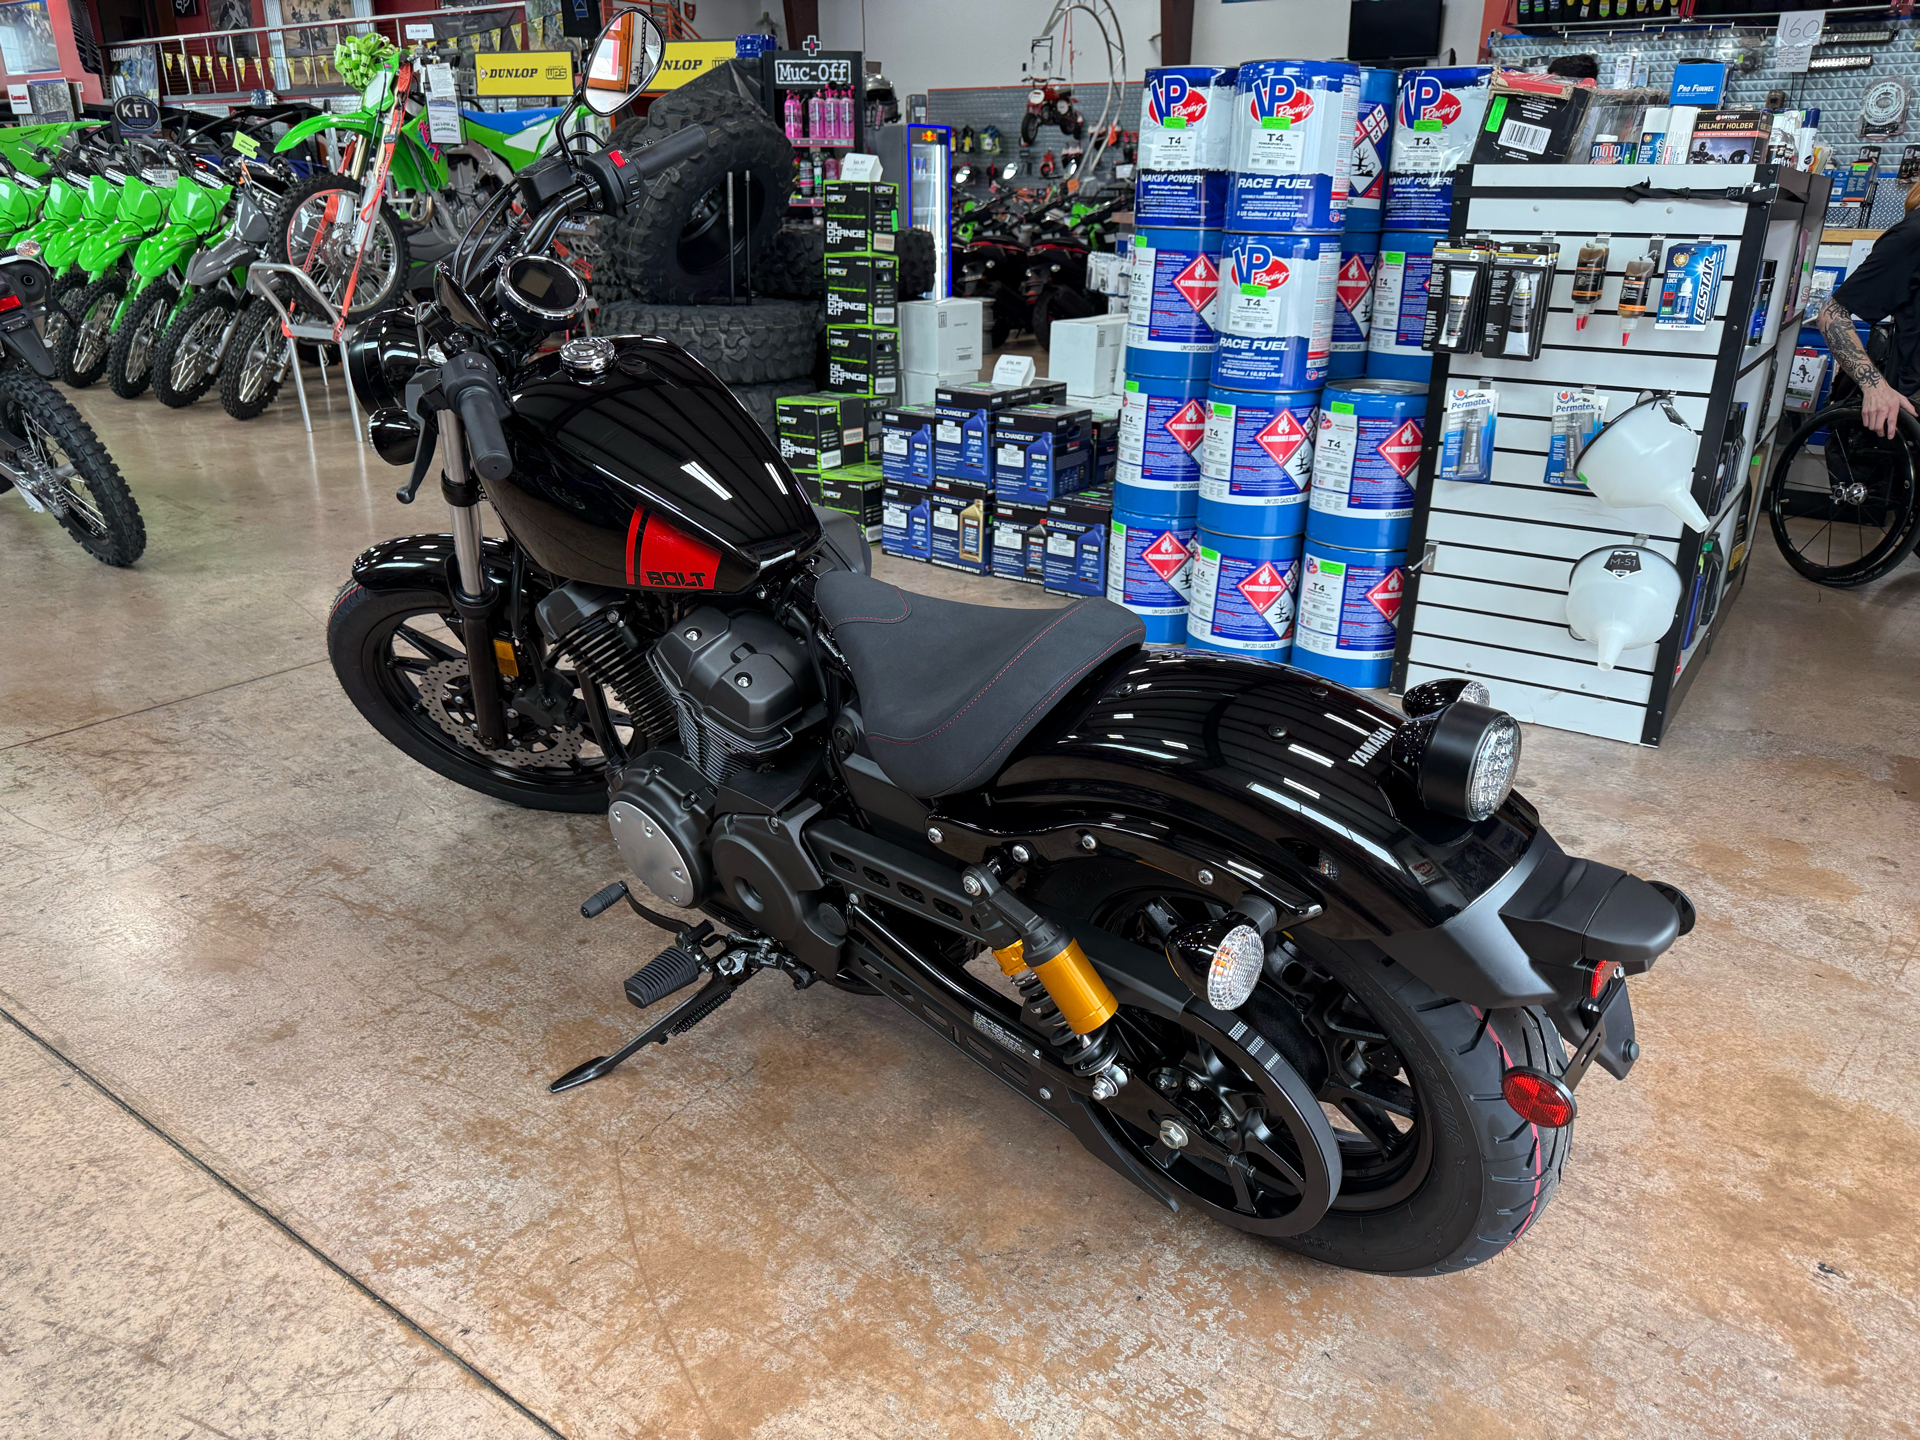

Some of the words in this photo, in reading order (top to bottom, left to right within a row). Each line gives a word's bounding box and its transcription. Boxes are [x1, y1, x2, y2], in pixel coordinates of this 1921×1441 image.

[1782, 18, 1819, 39] 160
[662, 59, 702, 70] NLOP
[489, 68, 538, 78] DUNLOP
[545, 68, 567, 80] WPS
[779, 63, 847, 81] Muc-Off
[1150, 75, 1189, 127] VP
[1252, 75, 1297, 123] VP
[1403, 77, 1443, 129] VP
[121, 104, 149, 118] KFI
[1173, 102, 1208, 117] Racing
[1277, 103, 1315, 118] Racing
[1423, 104, 1462, 119] Racing
[522, 113, 547, 127] Kawasaki
[1698, 122, 1724, 130] HELMET
[1168, 136, 1182, 145] T4
[1267, 133, 1284, 143] T4
[1413, 137, 1431, 146] T4
[1592, 145, 1620, 157] MOTO
[1167, 175, 1204, 184] POWER!
[1238, 178, 1273, 189] RACE
[1275, 179, 1314, 189] FUEL
[826, 221, 842, 230] OIL
[826, 229, 866, 238] CHANGE
[826, 236, 842, 244] KIT
[1468, 250, 1480, 262] 5
[1532, 255, 1548, 267] 4
[1232, 244, 1273, 290] VP
[1134, 273, 1142, 281] T4
[1254, 271, 1290, 286] Racing
[1379, 278, 1388, 286] T4
[1693, 251, 1718, 324] ECSTAR
[827, 293, 843, 301] OIL
[827, 301, 867, 311] CHANGE
[1245, 298, 1262, 307] T4
[827, 308, 843, 316] KIT
[1219, 337, 1251, 350] RACE
[1252, 341, 1290, 351] FUEL
[830, 363, 845, 372] OIL
[830, 371, 868, 382] CHANGE
[830, 377, 845, 385] KIT
[1451, 397, 1492, 410] Permatex
[1556, 403, 1596, 413] Permatex
[943, 409, 962, 417] CHANGE
[1125, 414, 1133, 423] T4
[1004, 432, 1027, 441] CHANGE
[1209, 428, 1219, 437] T4
[1262, 435, 1288, 443] FLAMMABLE
[1327, 439, 1341, 449] T4
[780, 445, 816, 456] CHANGE
[940, 496, 960, 506] CHANGE
[1280, 496, 1298, 504] GASOLINE
[1047, 520, 1055, 528] OIL
[1055, 521, 1077, 531] CHANGE
[1609, 558, 1636, 567] M-51
[1197, 568, 1205, 578] T4
[645, 571, 706, 587] BOLT
[1312, 582, 1325, 592] T4
[1347, 727, 1397, 767] YAMAHA
